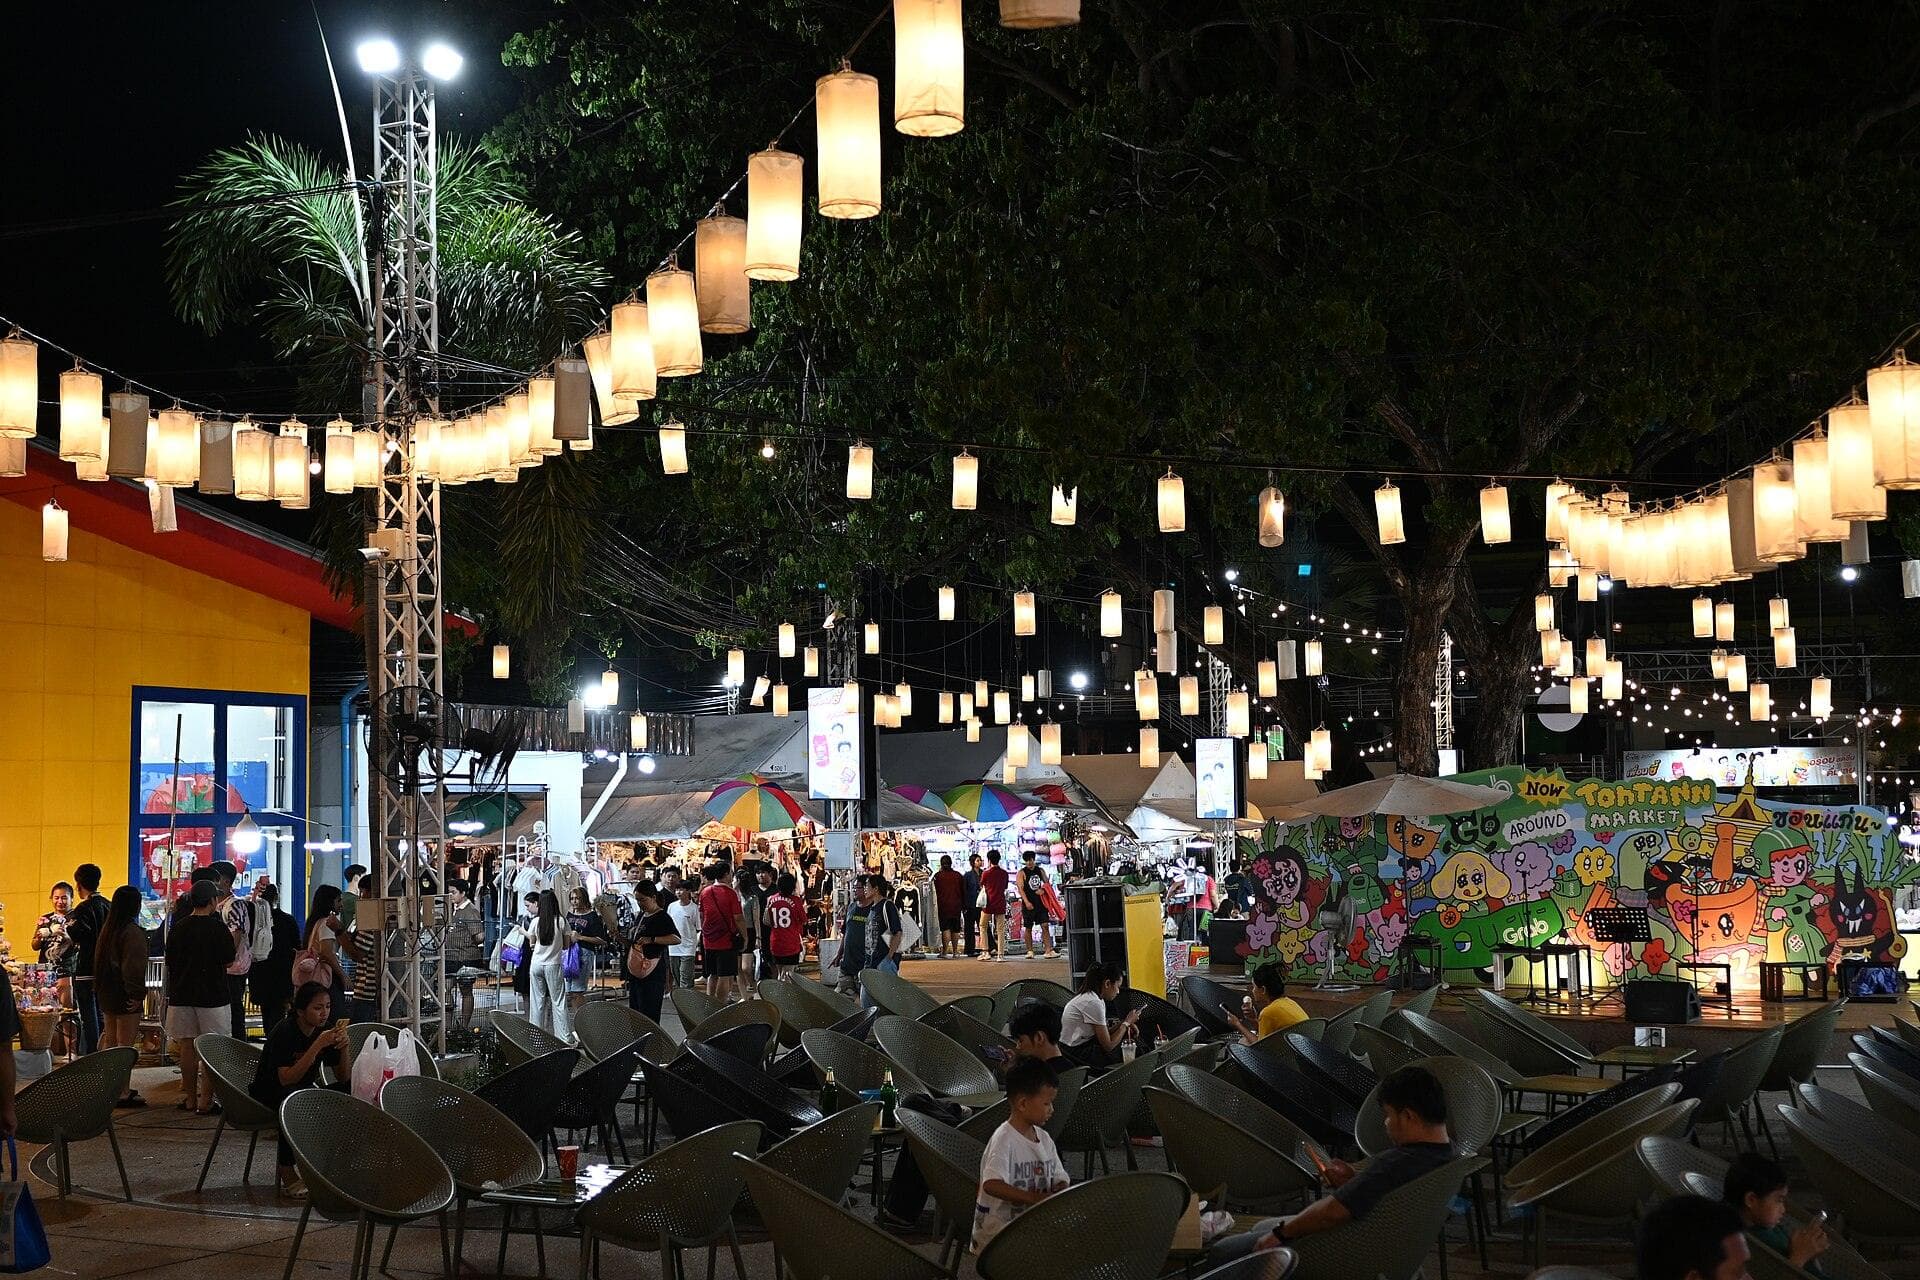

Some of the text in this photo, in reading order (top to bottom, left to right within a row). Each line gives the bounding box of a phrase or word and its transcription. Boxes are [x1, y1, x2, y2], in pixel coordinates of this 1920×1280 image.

[1525, 780, 1565, 798] NOW
[1509, 813, 1567, 840] AROUND
[1590, 809, 1680, 829] MARKET
[771, 907, 791, 929] 18
[1502, 917, 1549, 945] Grab
